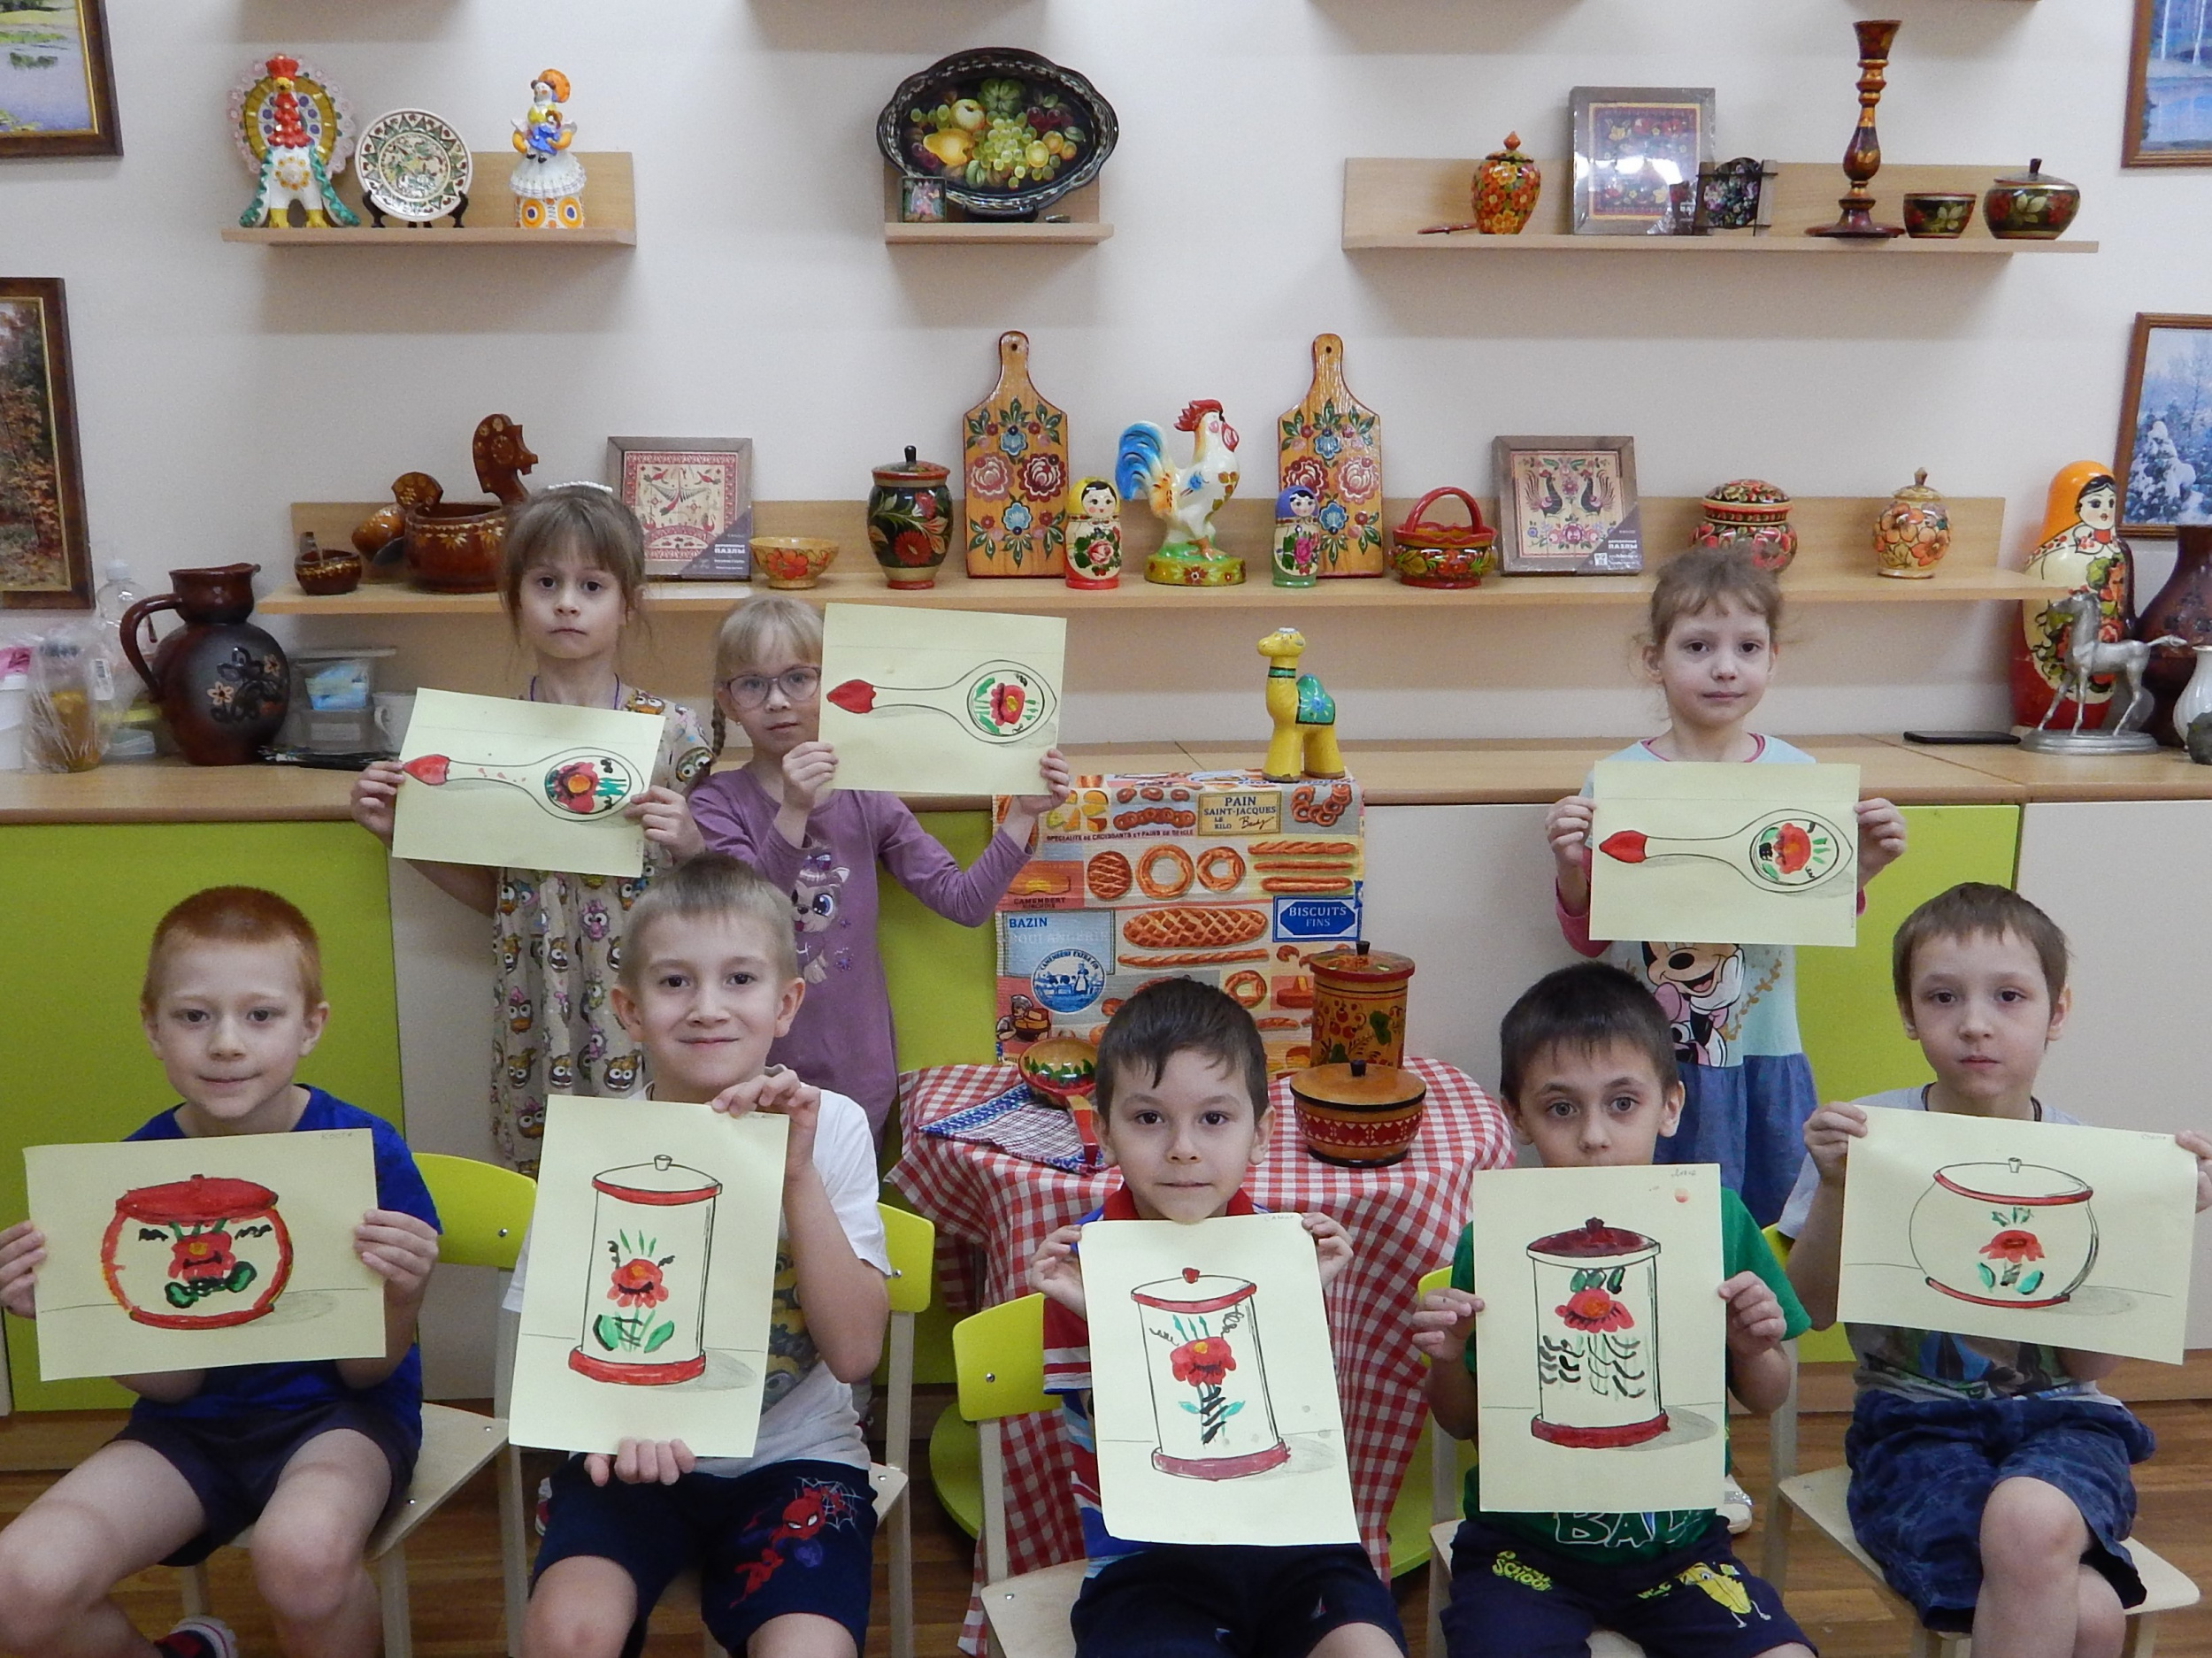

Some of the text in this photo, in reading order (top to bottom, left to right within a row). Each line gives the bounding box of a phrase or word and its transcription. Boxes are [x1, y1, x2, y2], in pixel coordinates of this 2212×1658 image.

[1225, 796, 1256, 806] PAIN
[1203, 806, 1276, 816] SAINT-JACQUES
[1289, 907, 1347, 917] BISCUITS
[1009, 917, 1048, 928] BAZIN
[1306, 917, 1331, 927] FINS
